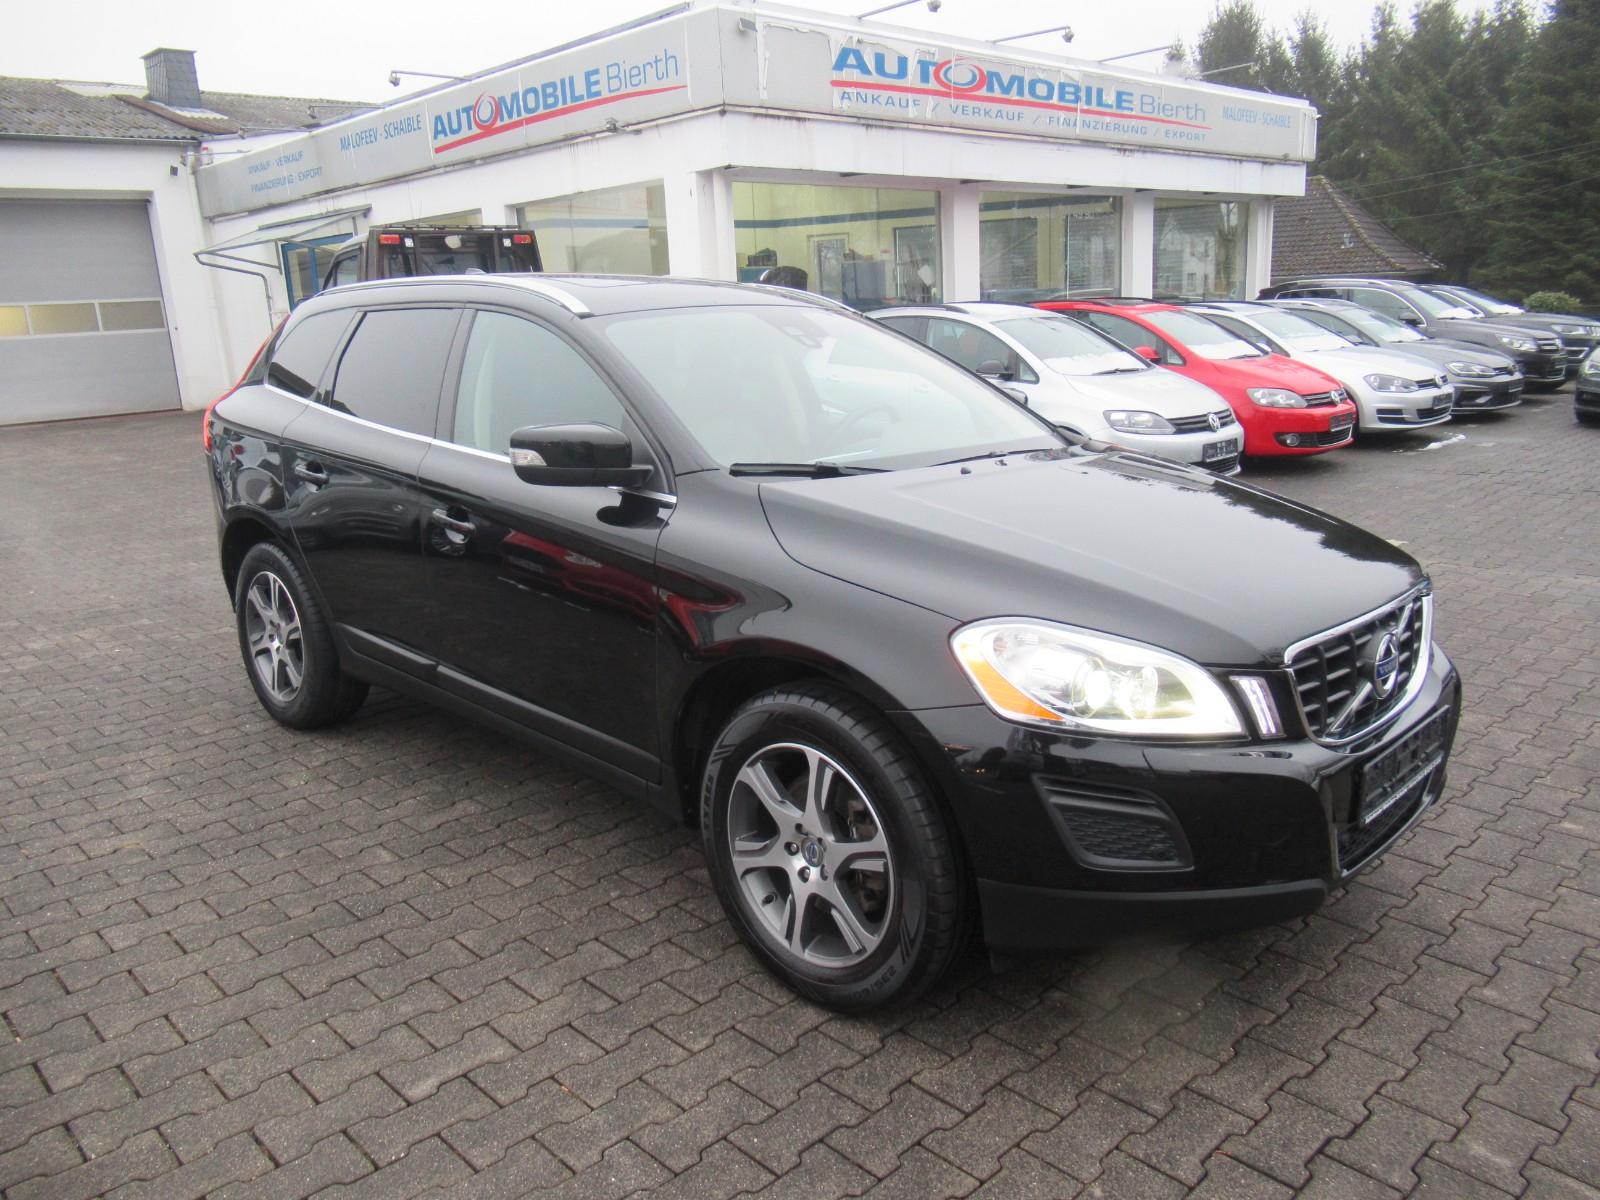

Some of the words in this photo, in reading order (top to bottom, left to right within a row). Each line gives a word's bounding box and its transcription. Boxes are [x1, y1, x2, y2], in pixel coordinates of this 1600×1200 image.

[433, 68, 602, 140] AUTOMOBILE
[606, 48, 679, 93] Bierth
[832, 47, 1133, 111] AUTOMOBILE
[1139, 94, 1206, 122] Bierth
[340, 132, 378, 152] MALOFEEV
[383, 114, 422, 140] SCHAIBLE
[841, 91, 921, 109] ANKAUF
[949, 104, 1025, 121] VERKAUF
[1048, 116, 1148, 135] FINANZIERUNG
[1164, 129, 1206, 142] EXPORT
[297, 166, 323, 182] EXPORT
